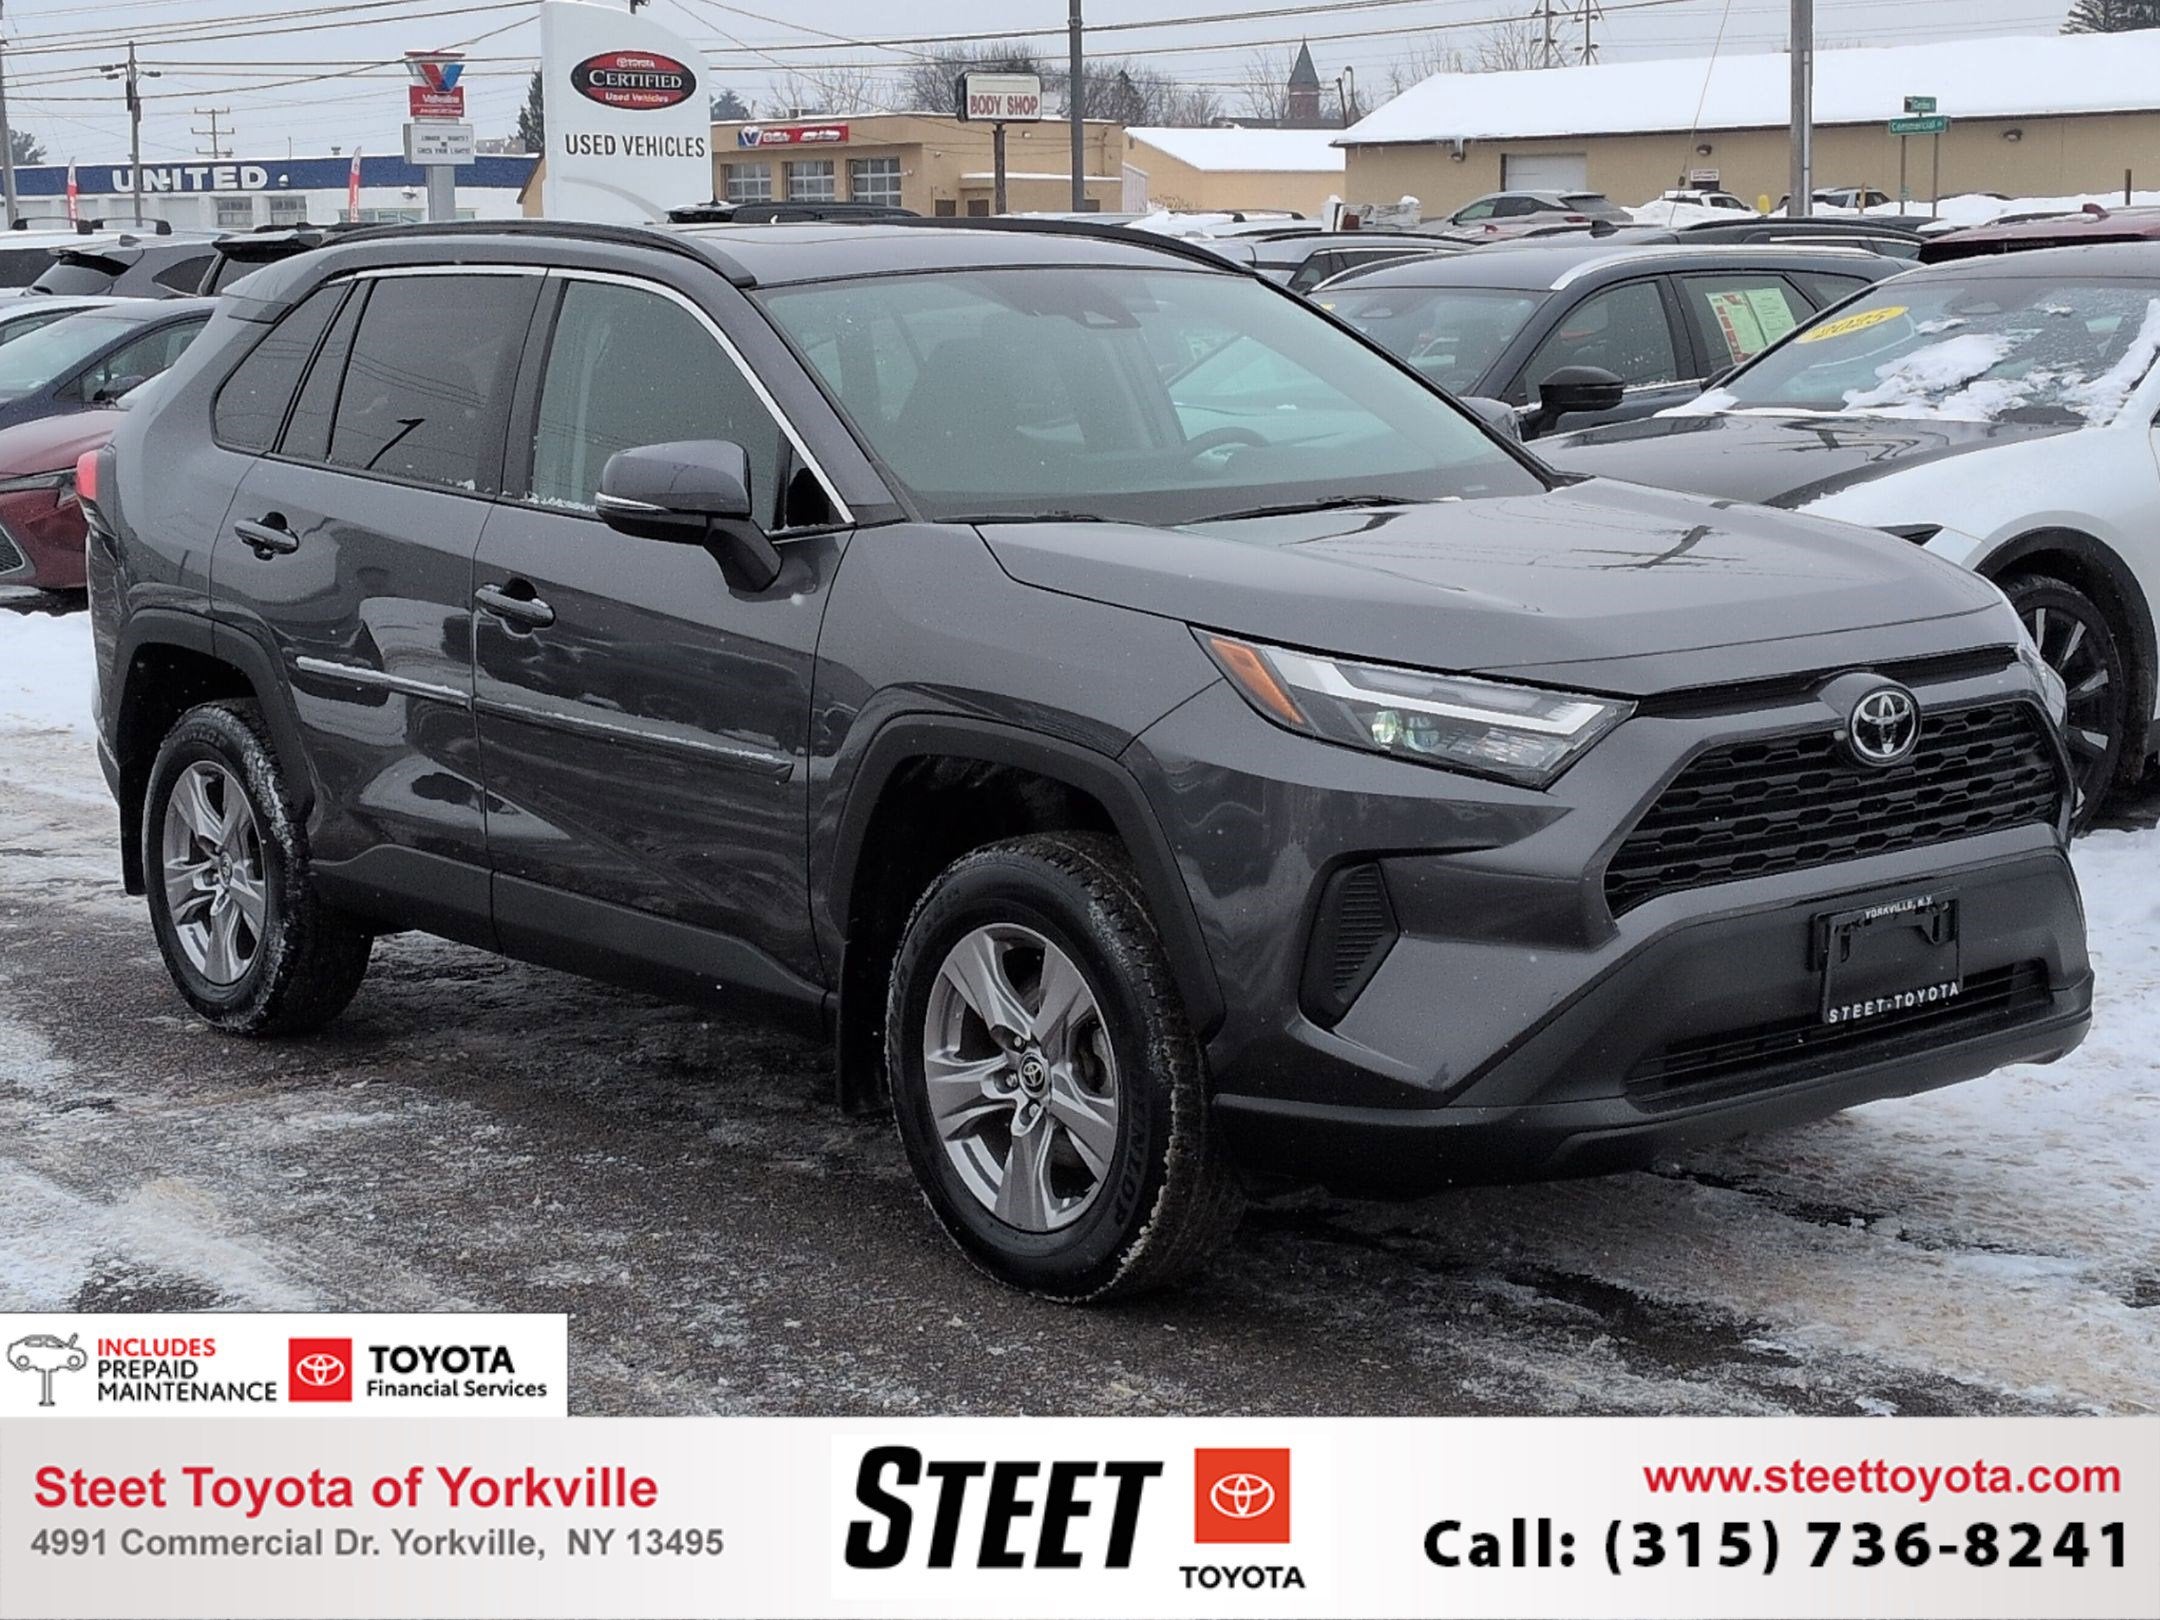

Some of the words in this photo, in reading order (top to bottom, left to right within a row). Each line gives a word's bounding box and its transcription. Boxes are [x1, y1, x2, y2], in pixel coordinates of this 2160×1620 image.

[589, 69, 682, 88] CERTIFIED
[605, 91, 630, 101] Used
[632, 93, 669, 103] Vehicles
[970, 95, 1001, 115] BODY
[1007, 95, 1038, 115] SHOP
[565, 133, 616, 156] USED
[622, 135, 706, 158] VEHICLES
[111, 165, 269, 193] UNITED
